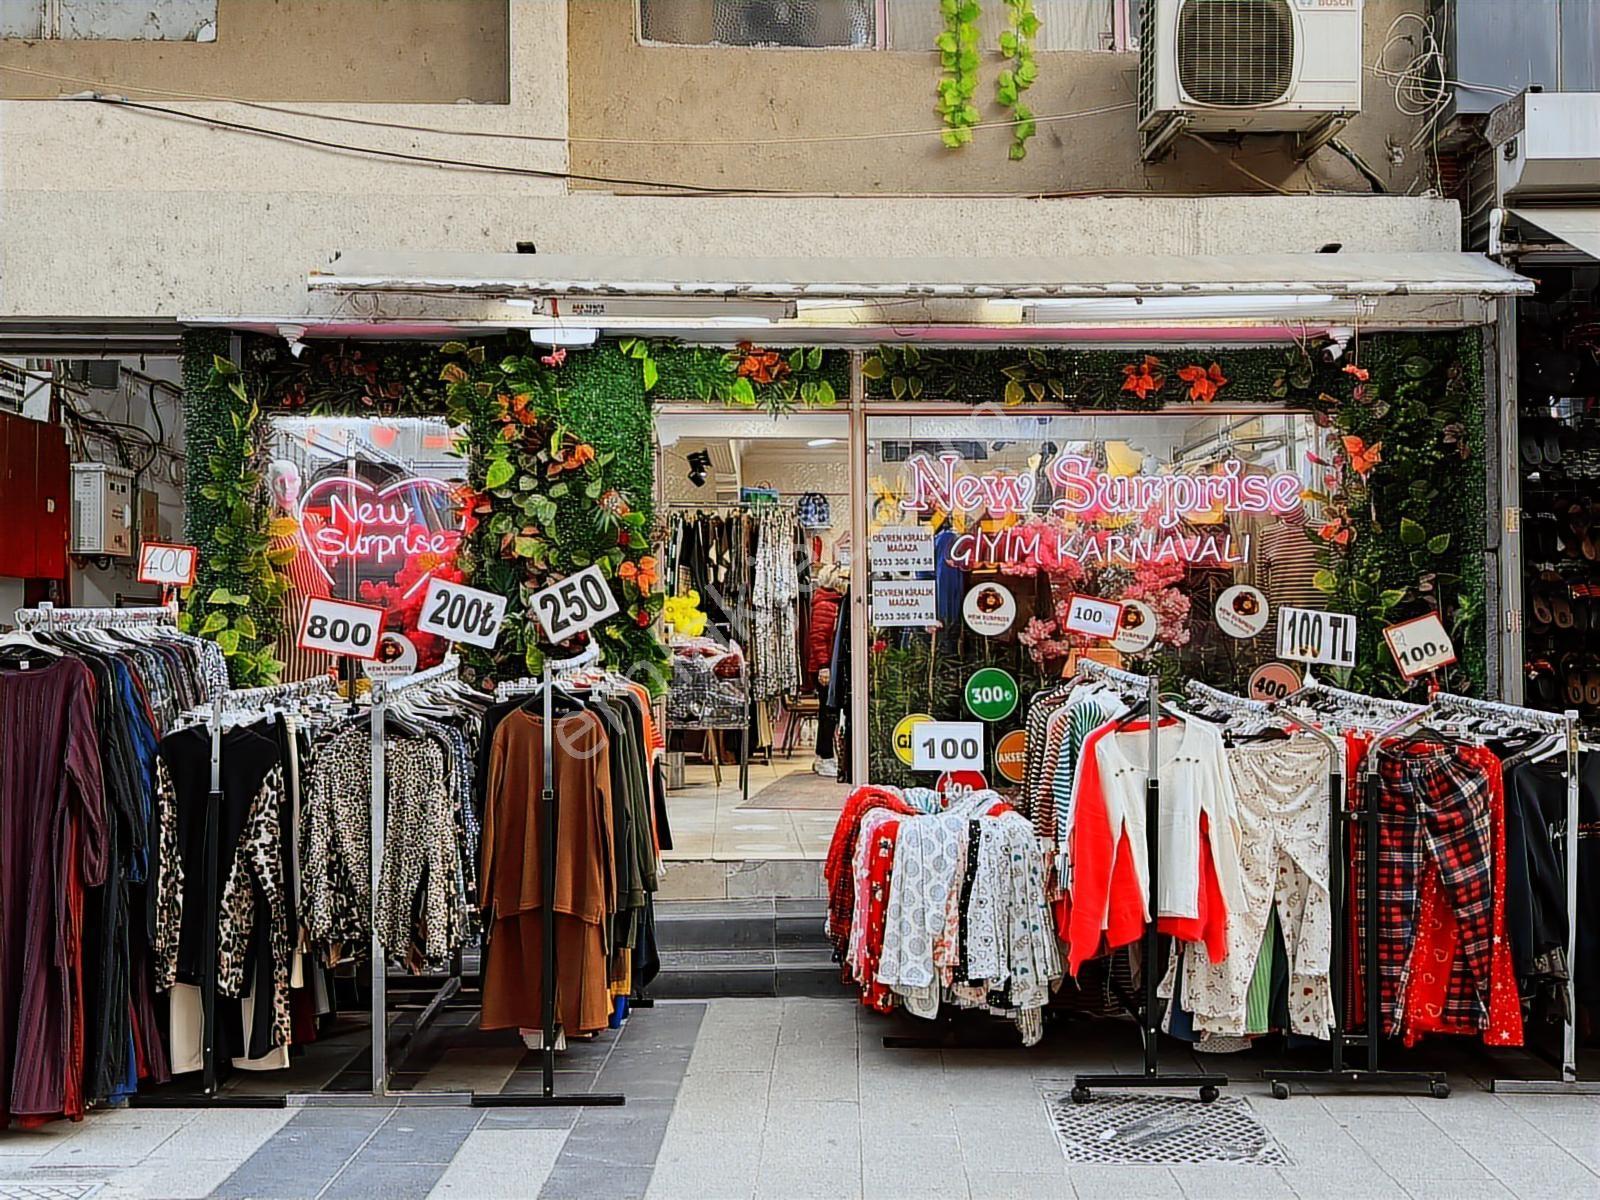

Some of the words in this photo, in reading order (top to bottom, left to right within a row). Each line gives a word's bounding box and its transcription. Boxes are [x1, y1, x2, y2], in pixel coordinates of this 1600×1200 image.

[899, 454, 1037, 512] New
[1052, 454, 1302, 529] Surprise
[329, 494, 414, 525] New
[316, 525, 450, 564] Surprise
[872, 534, 901, 543] DEVREN
[1057, 532, 1250, 564] KARNAVALI
[143, 547, 193, 578] 400
[873, 557, 893, 566] 0553
[895, 557, 910, 566] 306
[911, 557, 922, 566] 74
[539, 573, 608, 634] 250
[874, 611, 894, 620] 0553
[895, 611, 911, 620] 306
[912, 611, 923, 620] 74
[924, 611, 935, 620] 58
[1073, 606, 1103, 623] 100
[306, 614, 372, 647] 800
[1287, 610, 1323, 659] 100
[1329, 615, 1353, 662] TL
[1254, 676, 1291, 700] 400
[921, 737, 979, 760] 100
[998, 751, 1026, 763] AKSE
